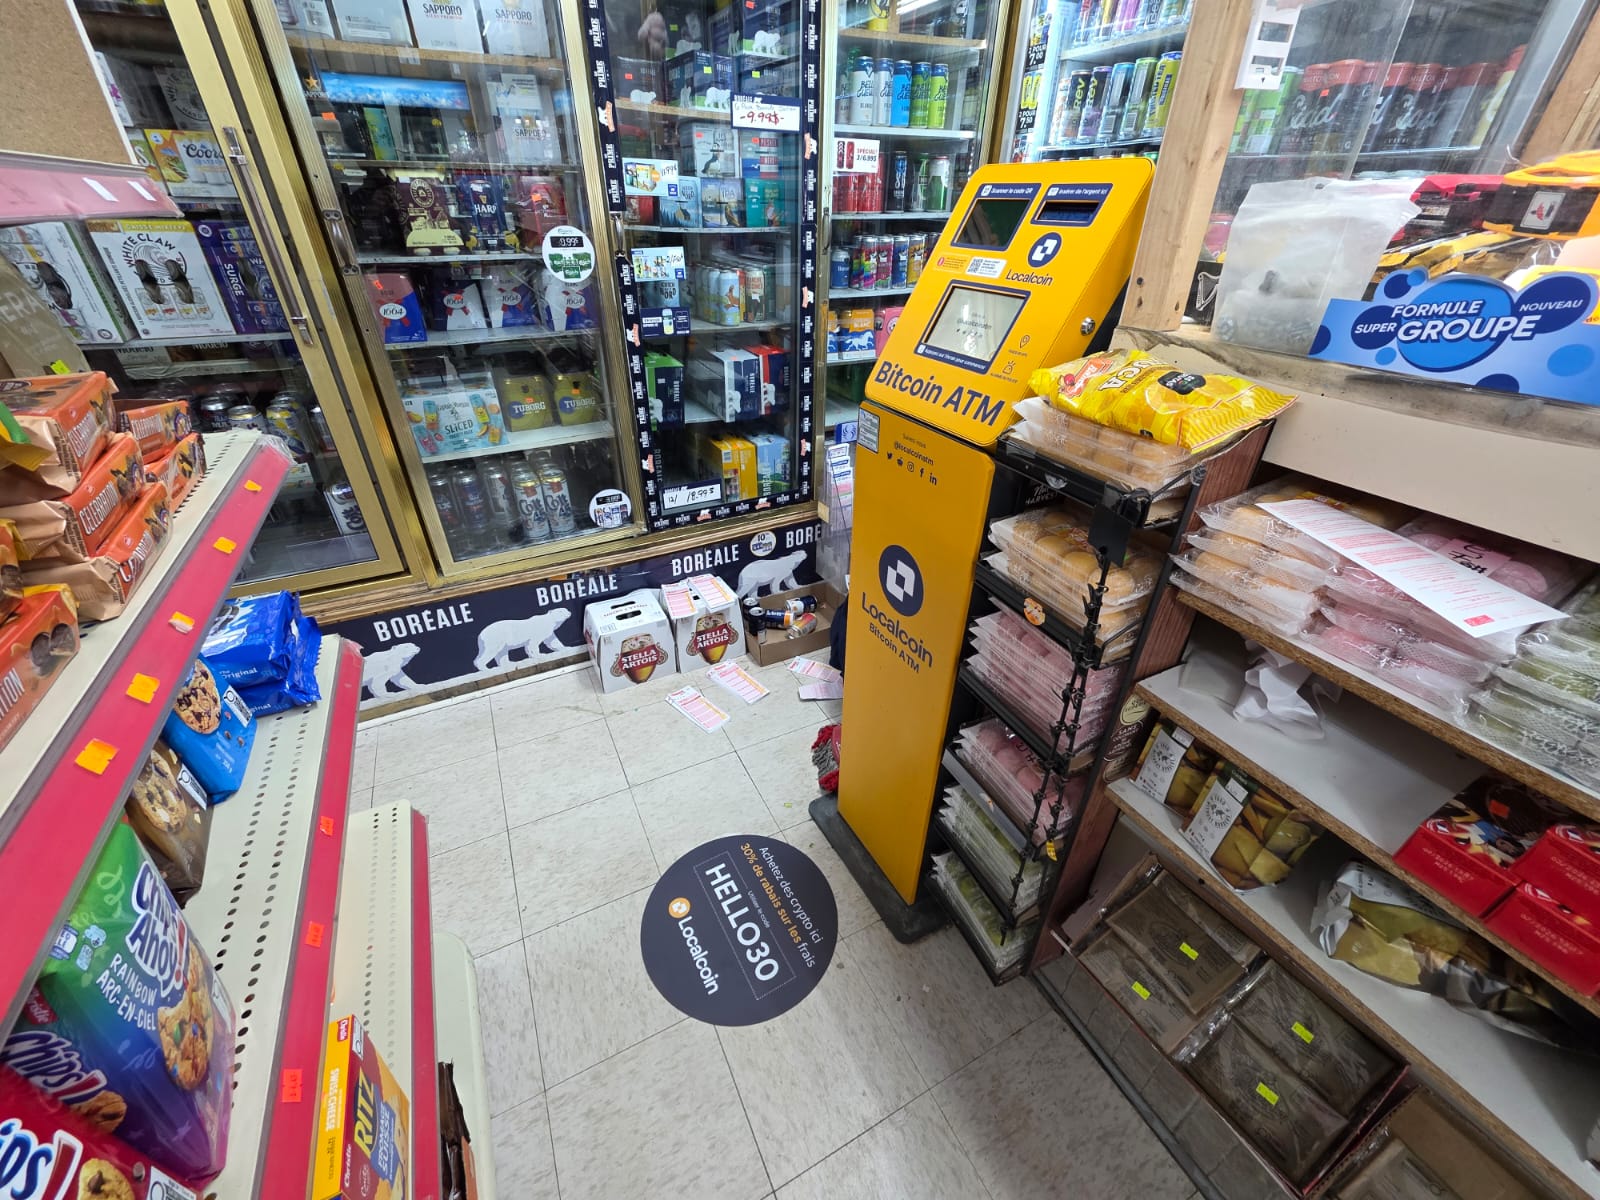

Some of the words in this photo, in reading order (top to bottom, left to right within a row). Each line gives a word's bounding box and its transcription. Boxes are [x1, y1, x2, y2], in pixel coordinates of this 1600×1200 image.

[423, 3, 462, 16] SAPPORO
[496, 8, 532, 20] SAPPORO
[590, 17, 602, 47] PRIME
[1033, 43, 1046, 52] POUR
[596, 60, 607, 88] PRIME
[1074, 78, 1086, 109] Rev
[605, 143, 616, 168] PRIME
[610, 179, 620, 203] PRIME
[475, 204, 497, 214] HARP
[122, 235, 137, 268] WHITE
[137, 232, 176, 251] CLAW
[224, 263, 245, 296] SURGE
[622, 263, 631, 285] PRIME
[1006, 269, 1053, 286] Localcoin
[383, 308, 404, 316] 1664
[567, 297, 583, 305] 1664
[625, 294, 634, 314] PRIME
[1391, 300, 1483, 318] FORMULE
[1519, 299, 1583, 312] NOUVEAU
[1355, 322, 1397, 334] SUPER
[1399, 315, 1542, 341] GROUPE
[632, 355, 641, 373] PRIME
[635, 381, 643, 400] PRIME
[875, 360, 942, 404] Bitcoin
[943, 386, 1005, 427] ATM
[512, 402, 546, 413] TUBORG
[564, 398, 595, 408] TUBORG
[638, 407, 646, 424] PRIME
[641, 431, 649, 449] PRIME
[894, 441, 934, 465] @localcoinatm
[79, 481, 118, 535] CELEBRATION
[519, 498, 543, 515] Colt
[786, 524, 821, 549] BORÉ
[672, 545, 739, 576] BORÉALE
[536, 574, 617, 606] BORÉALE
[373, 603, 473, 642] BORÉALE
[862, 591, 933, 668] Localcoin
[696, 629, 728, 641] STELLA
[697, 635, 729, 649] ARTOIS
[621, 650, 656, 662] STELLA
[869, 622, 897, 653] Bitcoin
[898, 650, 920, 674] ATM
[622, 656, 657, 670] ARTOIS
[740, 843, 758, 864] 30%
[752, 864, 764, 877] de
[760, 877, 781, 908] rabais
[778, 908, 792, 925] sur
[788, 925, 802, 943] les
[797, 942, 816, 967] frais
[759, 847, 784, 881] Achetez
[780, 881, 794, 898] des
[790, 898, 813, 930] crypto
[809, 929, 824, 943] ici
[705, 863, 779, 981] HELLO30
[760, 914, 770, 928] code
[125, 911, 187, 998] Ahoy!
[678, 916, 720, 995] Localcoin
[110, 953, 157, 1006] RAINBOW
[95, 972, 157, 1032] ARC-EN-CIEL
[329, 1067, 340, 1095] SWISS
[326, 1095, 337, 1131] CHEESE
[354, 1067, 374, 1160] RITZ
